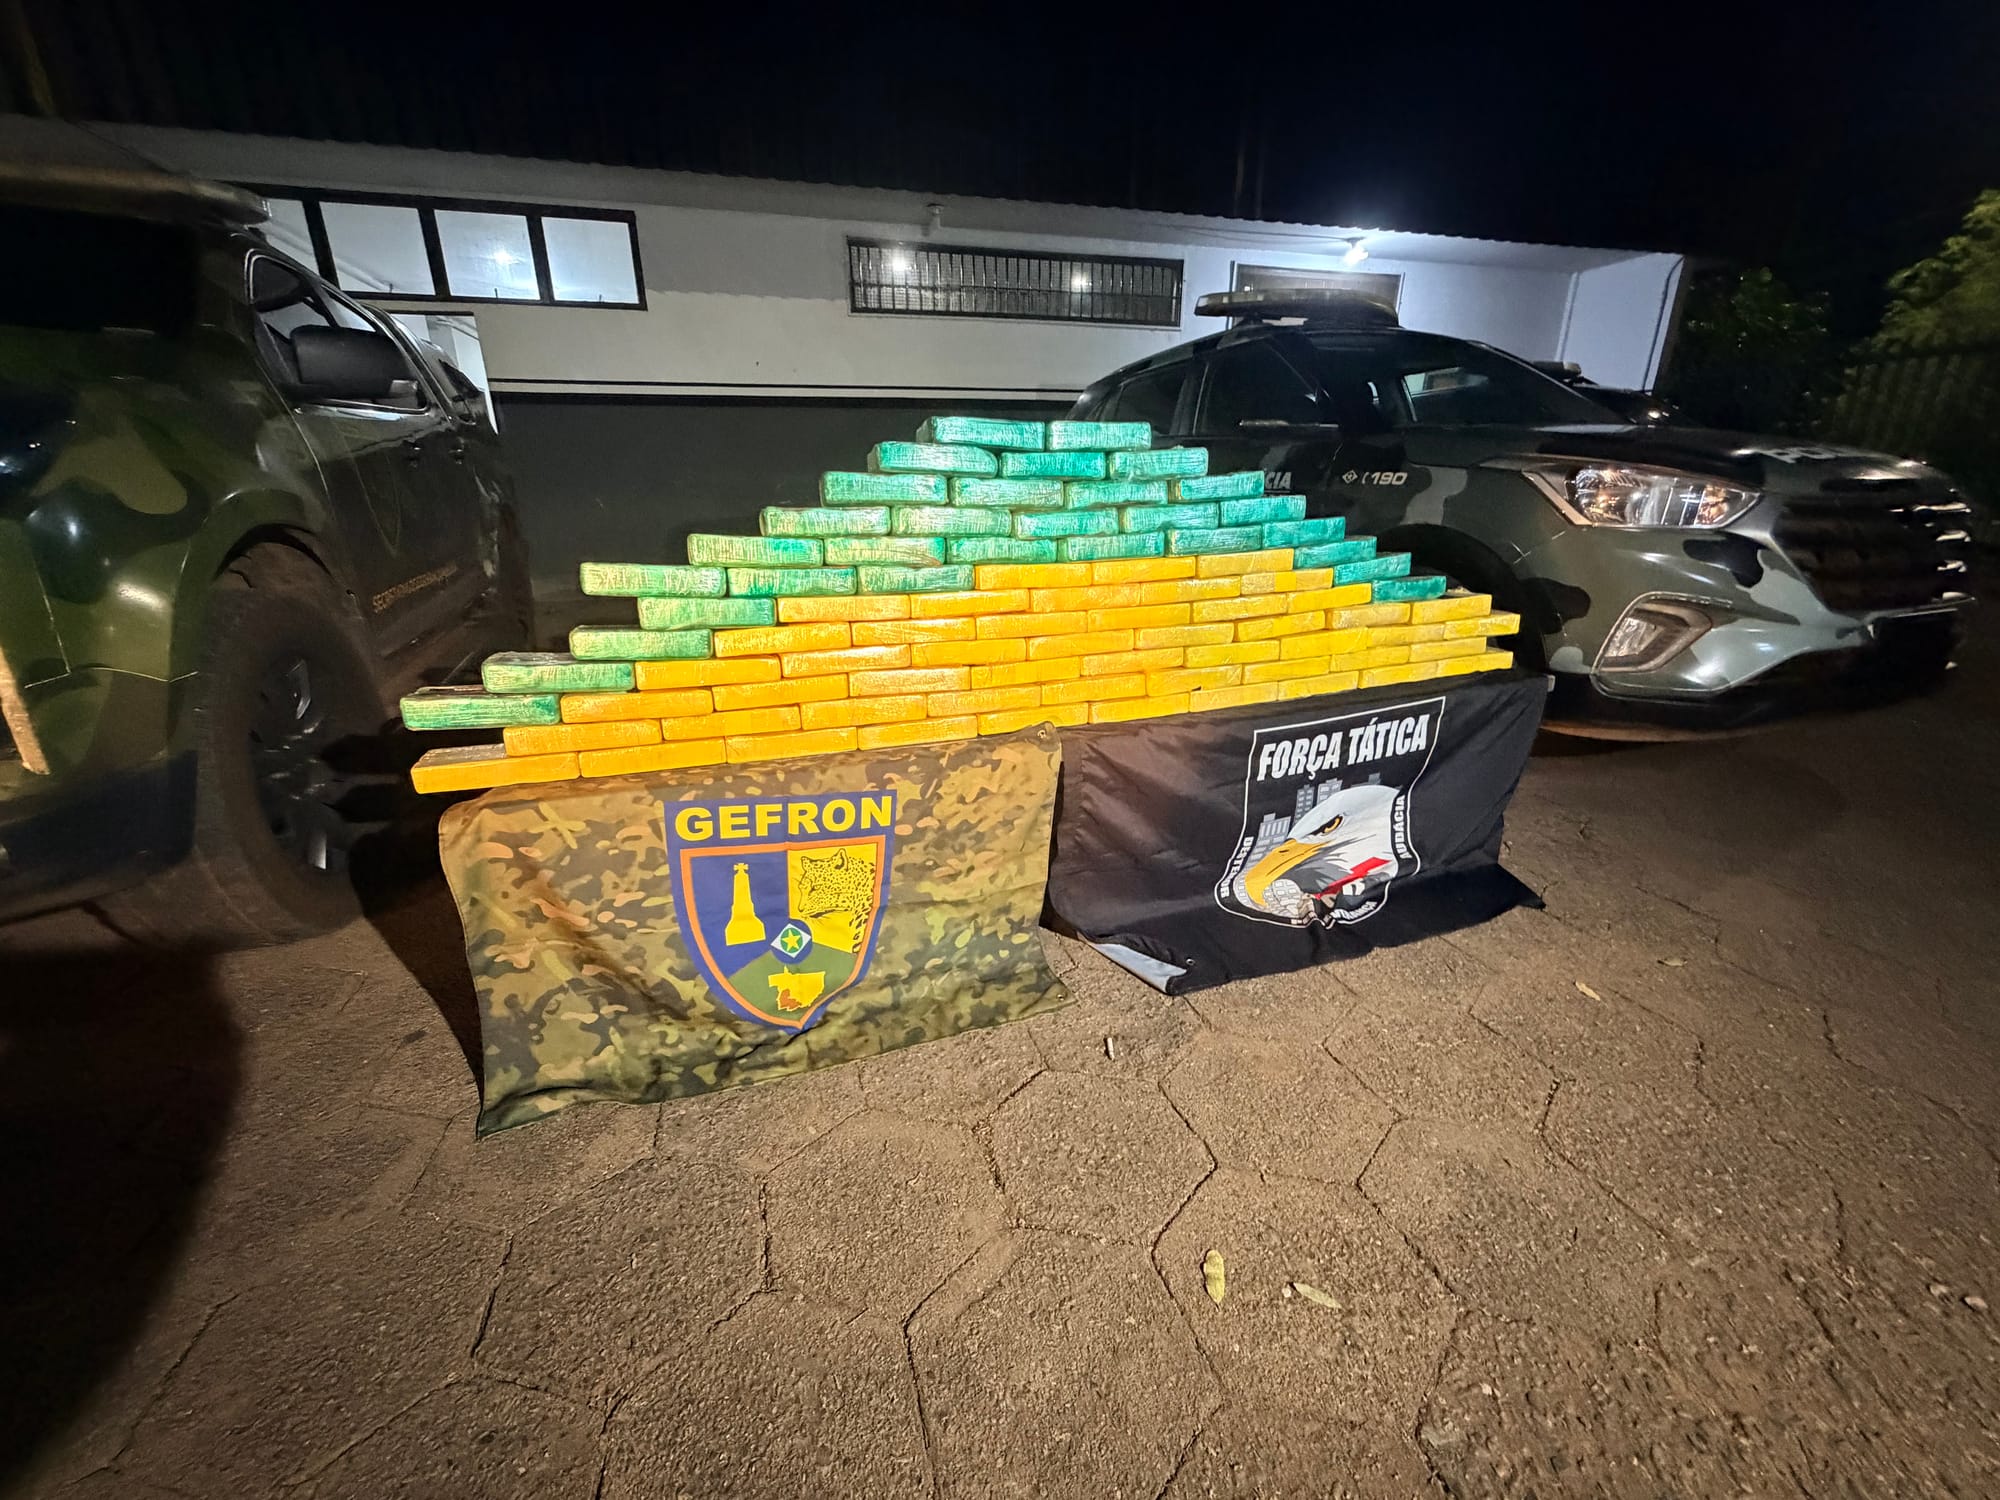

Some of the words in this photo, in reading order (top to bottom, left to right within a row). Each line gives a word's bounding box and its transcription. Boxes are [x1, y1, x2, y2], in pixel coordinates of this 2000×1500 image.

[1371, 472, 1408, 485] 190
[1257, 731, 1343, 780] FORÇA
[1347, 714, 1431, 765] TÁTICA
[674, 796, 892, 842] GEFRON
[1393, 795, 1413, 859] AUDÁCIA
